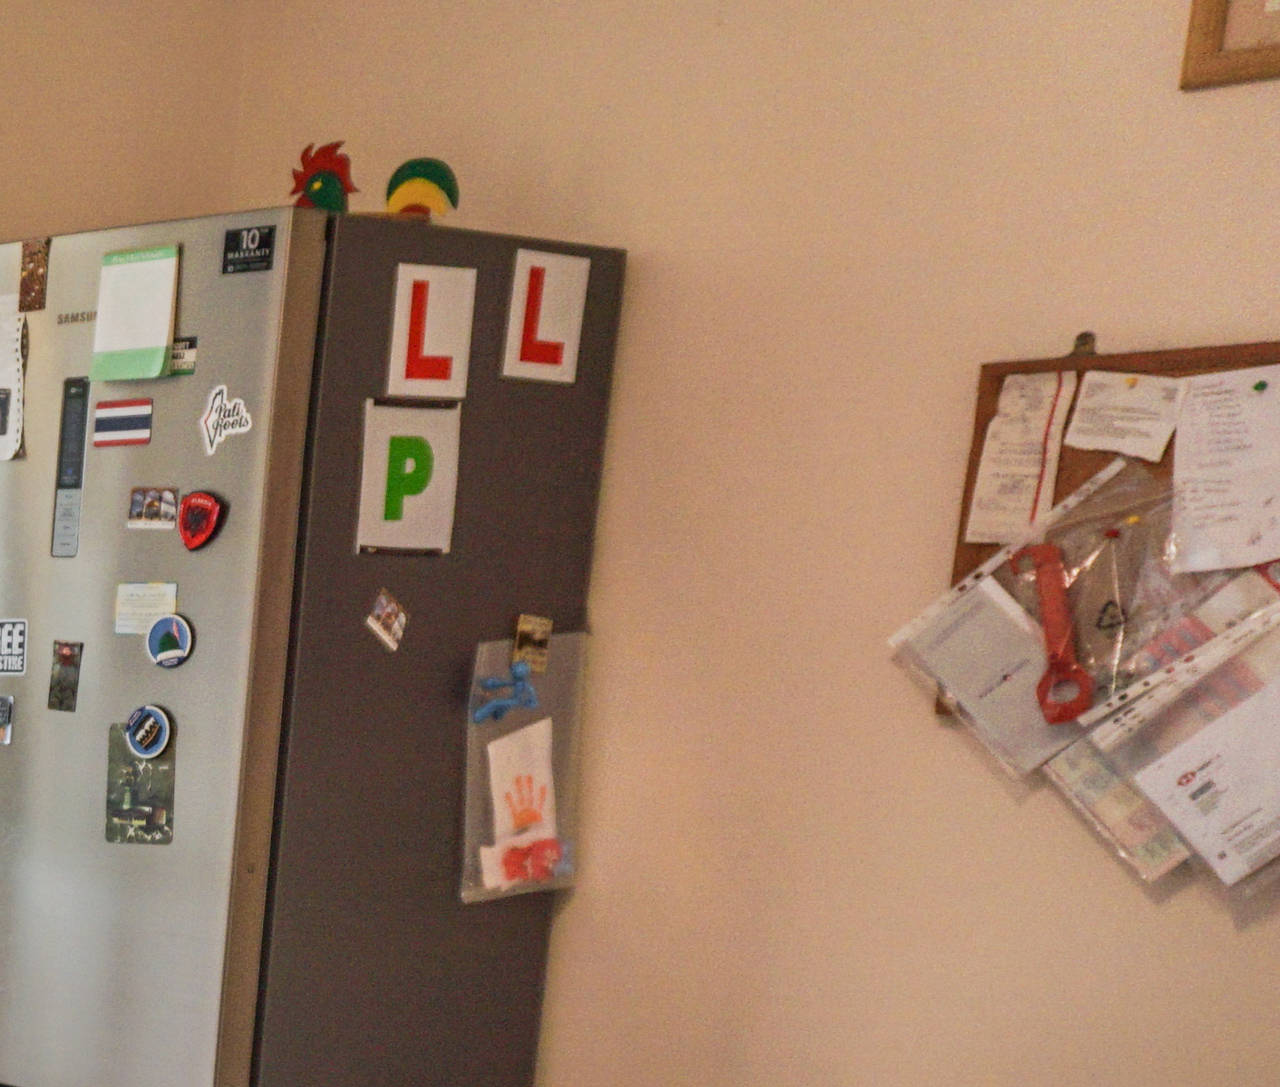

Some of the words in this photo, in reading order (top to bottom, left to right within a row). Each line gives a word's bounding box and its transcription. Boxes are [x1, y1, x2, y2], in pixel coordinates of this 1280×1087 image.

[241, 228, 260, 249] 10
[405, 280, 453, 380] L
[520, 266, 565, 365] L
[212, 415, 250, 437] Roots
[215, 401, 241, 419] Pali
[384, 436, 435, 521] P
